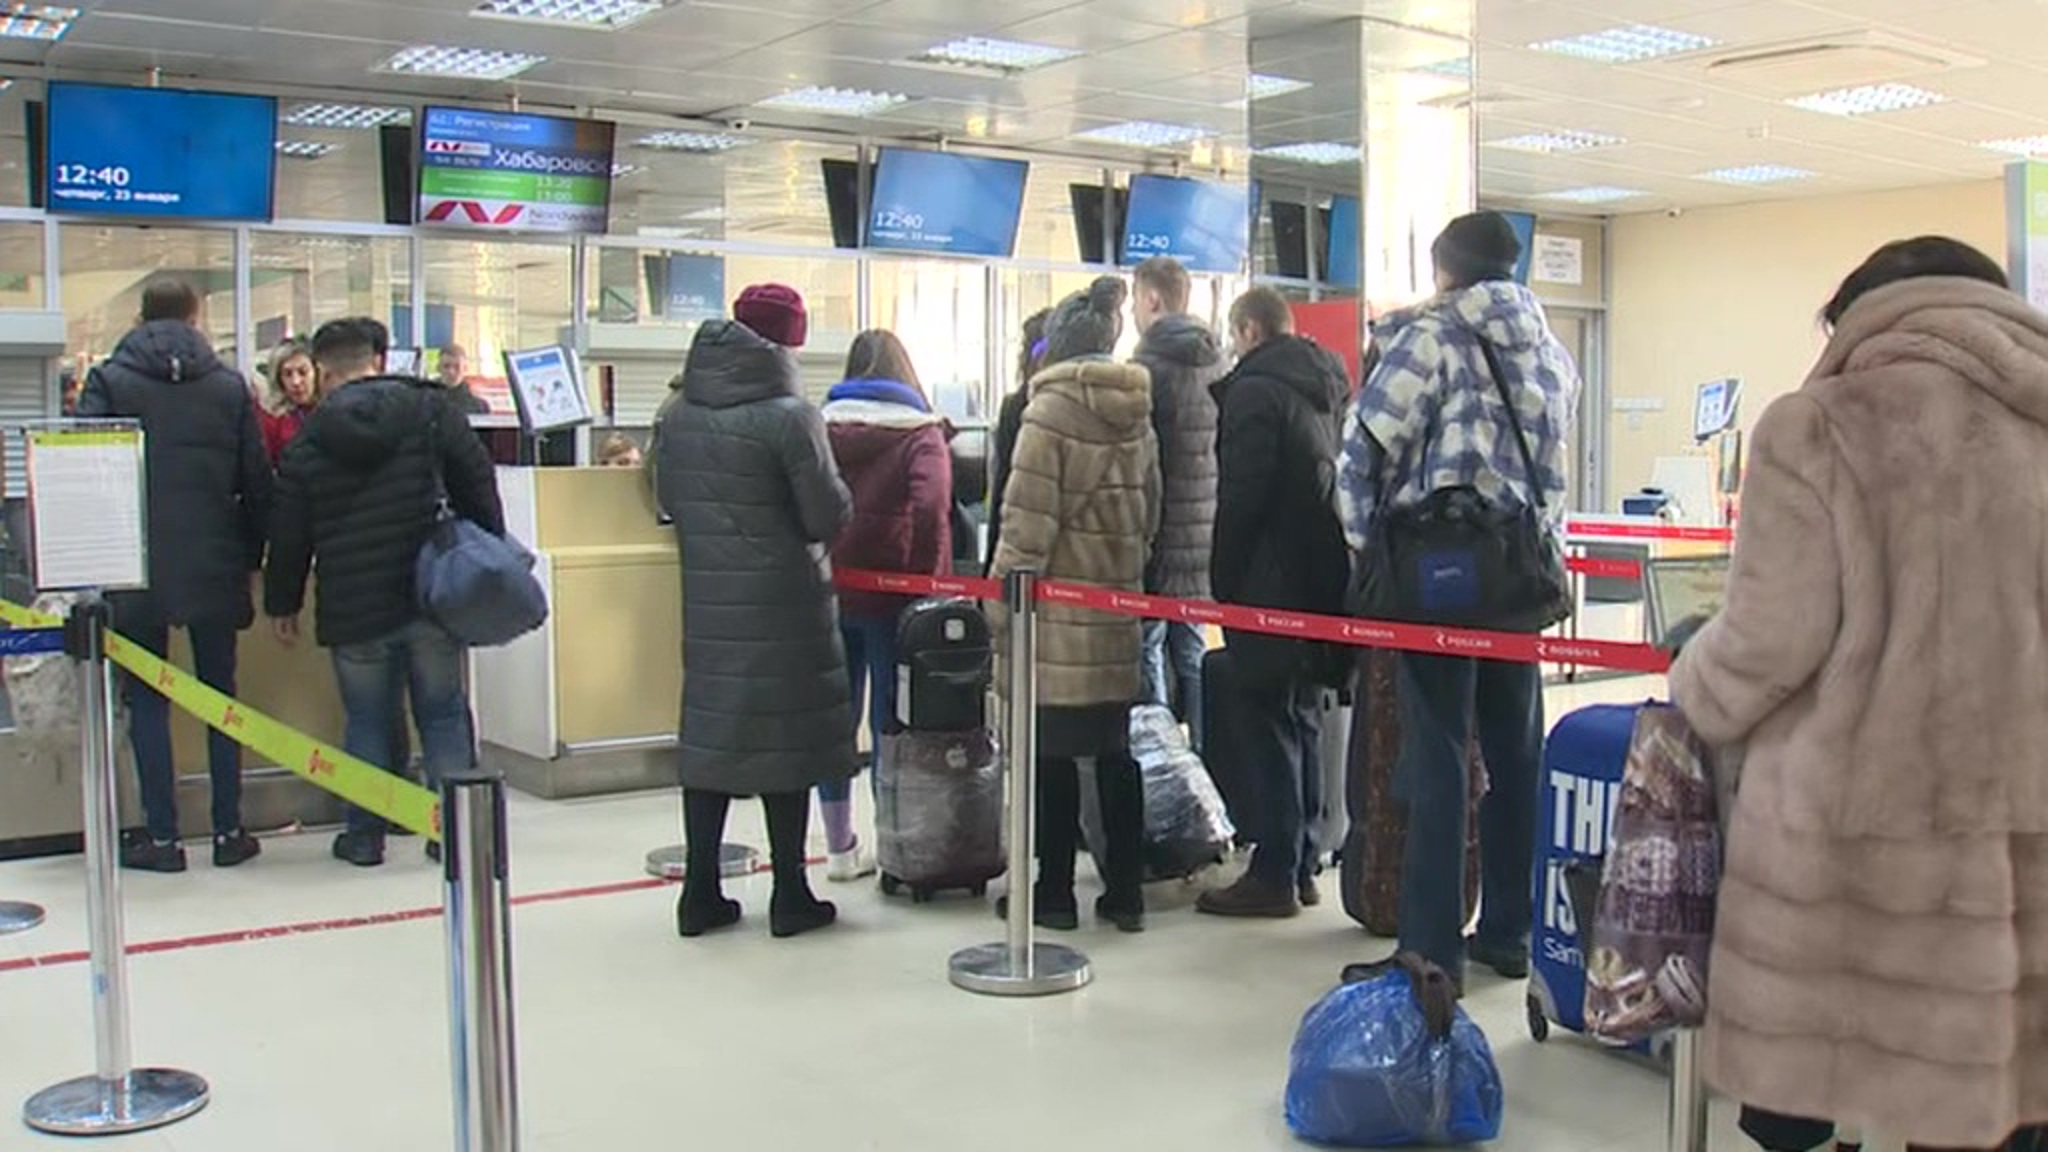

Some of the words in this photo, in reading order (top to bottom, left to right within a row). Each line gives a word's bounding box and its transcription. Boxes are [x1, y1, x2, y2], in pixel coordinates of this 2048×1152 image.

[57, 164, 130, 187] 12:40
[876, 211, 924, 229] 12:40
[1129, 233, 1169, 249] 12:40
